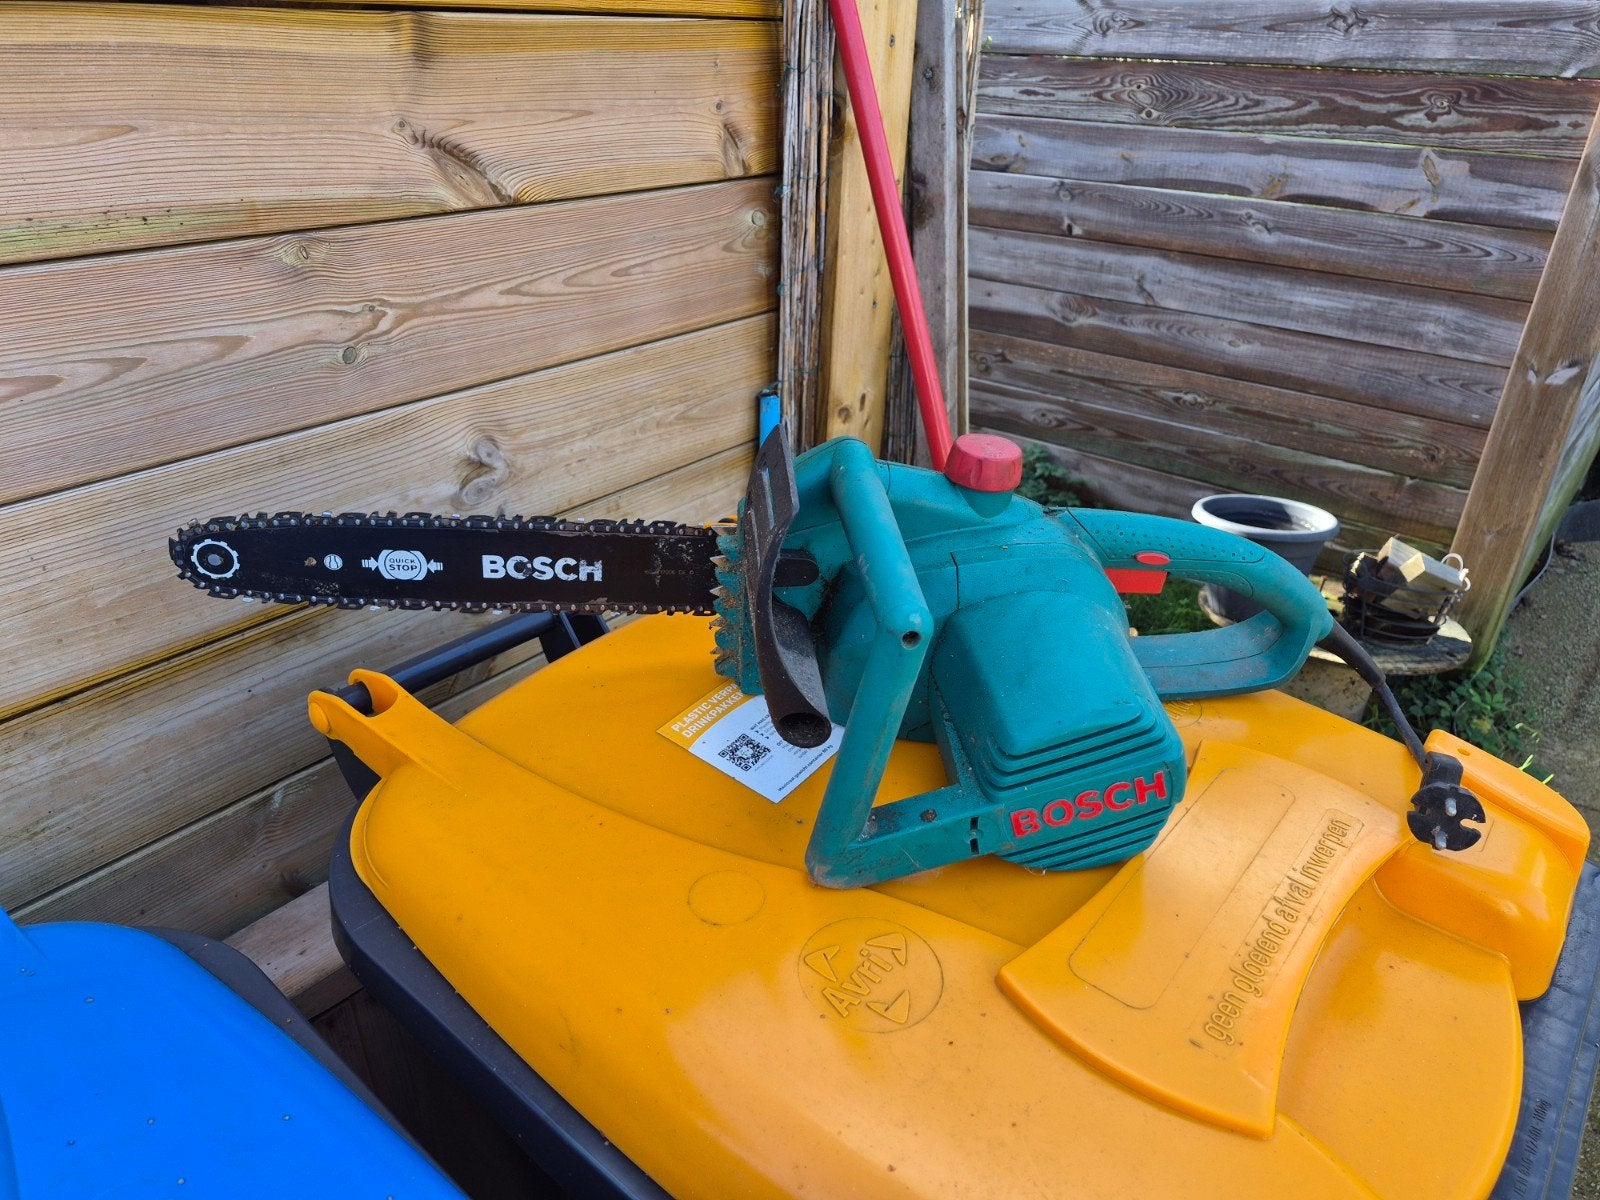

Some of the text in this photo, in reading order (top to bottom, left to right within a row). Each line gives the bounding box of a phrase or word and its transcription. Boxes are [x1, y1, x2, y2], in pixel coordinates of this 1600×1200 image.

[388, 563, 418, 571] STOP
[481, 555, 603, 582] BOSCH
[671, 702, 712, 732] PLASTIC
[1009, 771, 1168, 838] BOSCH
[1203, 818, 1352, 1046] geen gloeiend afval inwerpen
[821, 949, 893, 1018] Avri
